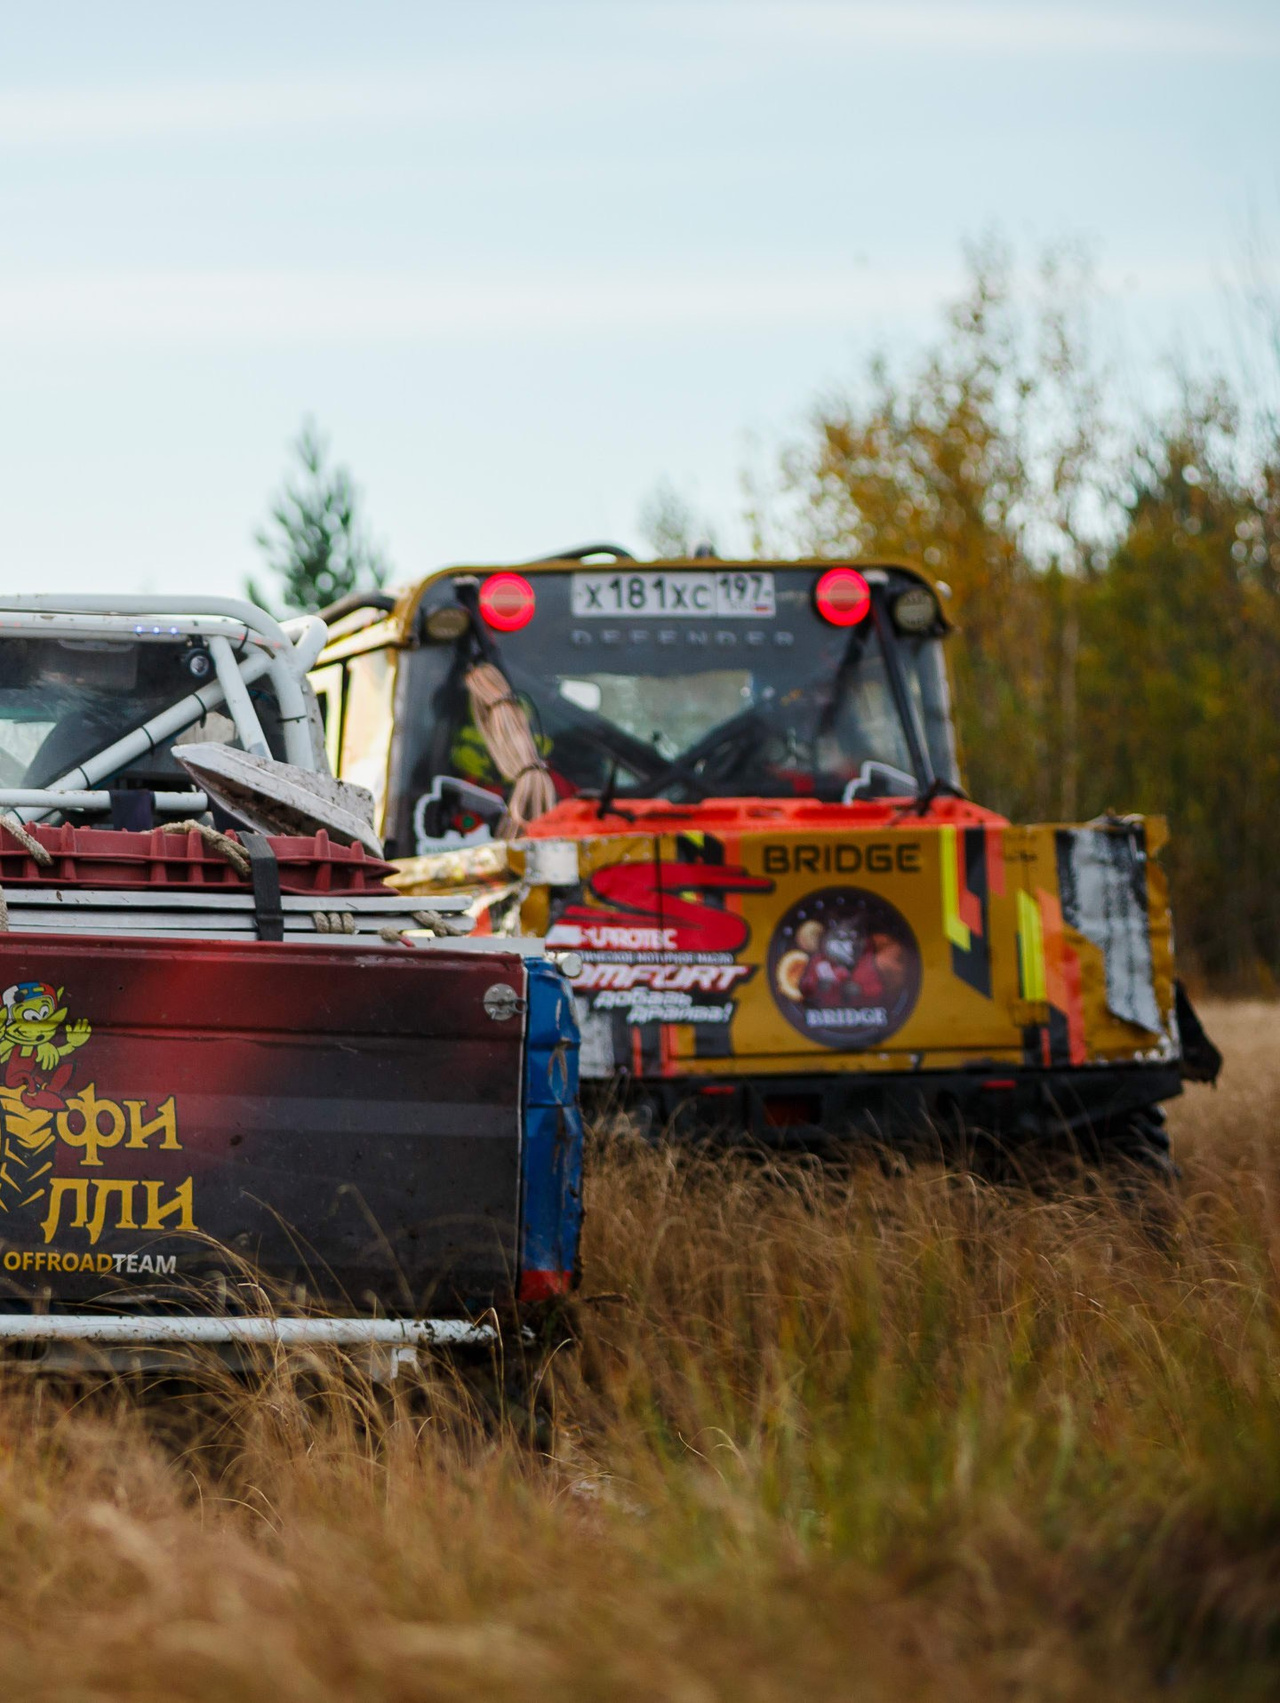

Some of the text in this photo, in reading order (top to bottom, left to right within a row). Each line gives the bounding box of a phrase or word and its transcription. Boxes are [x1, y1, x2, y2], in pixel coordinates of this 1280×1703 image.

[720, 574, 764, 602] 197
[573, 629, 794, 646] DEFENDER
[763, 843, 922, 874] BRIDGE
[571, 964, 749, 989] OMFORT
[805, 1007, 888, 1027] BRIDGE
